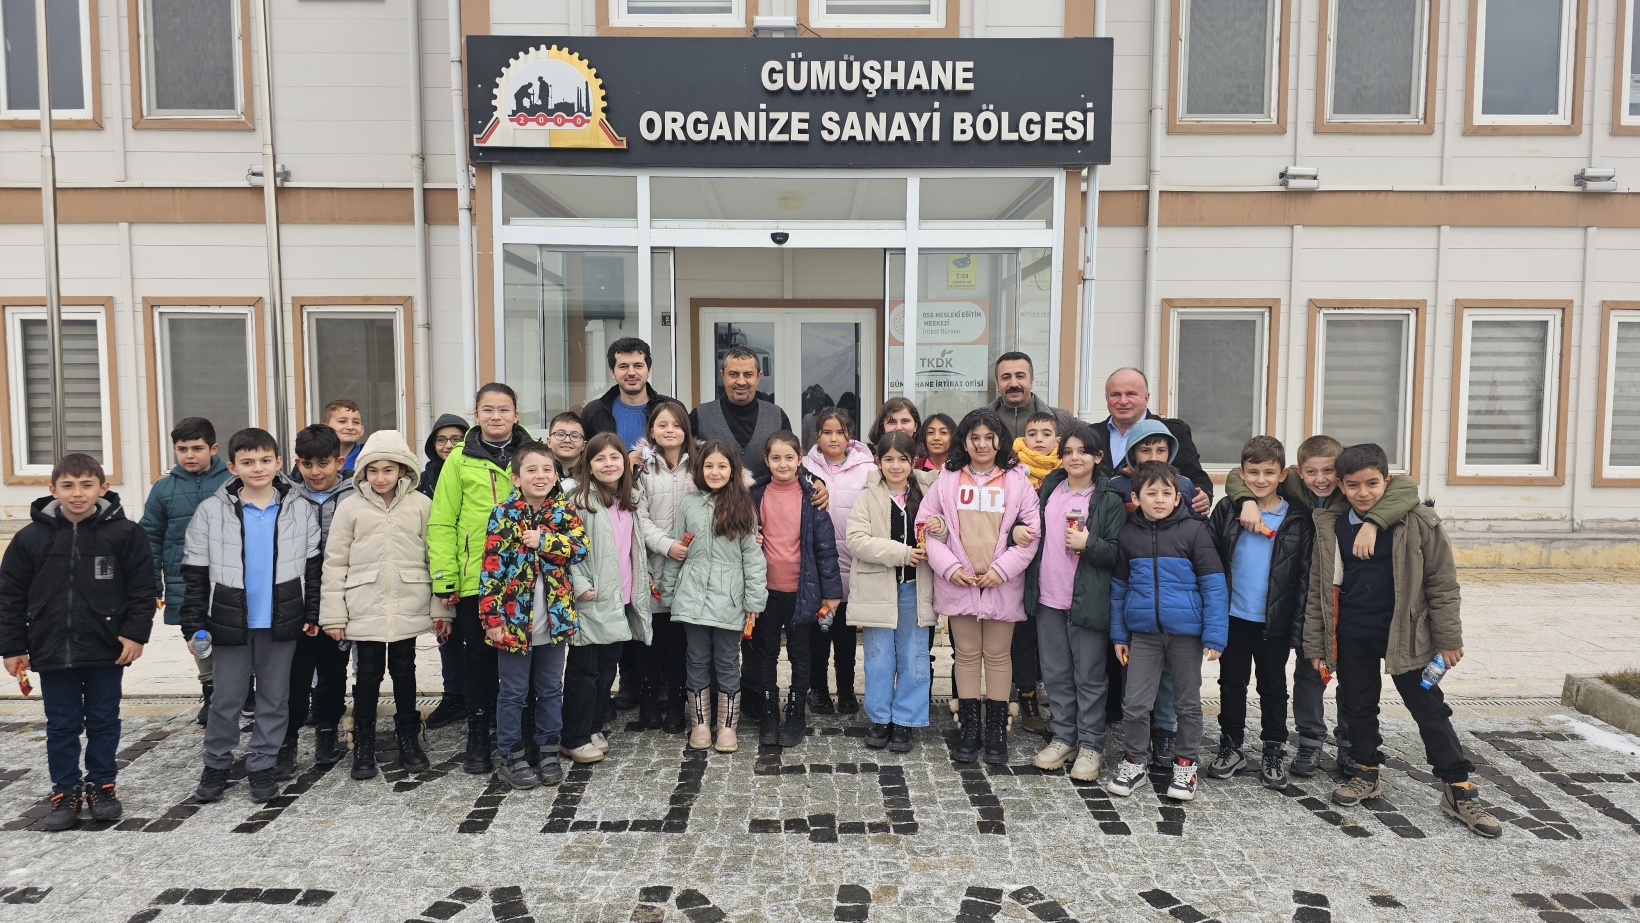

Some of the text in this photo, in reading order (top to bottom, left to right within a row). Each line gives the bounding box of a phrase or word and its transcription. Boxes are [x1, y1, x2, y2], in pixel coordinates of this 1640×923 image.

[761, 52, 974, 98] GÜMÜŞHANE
[519, 116, 582, 125] 2000
[639, 101, 1095, 142] ORGANİZE SANAYİ BÖLGESİ
[923, 319, 950, 327] MERKEZİ
[920, 357, 953, 368] TKDK
[935, 379, 963, 388] İRTİBAT
[965, 379, 984, 387] OFİSİ
[960, 489, 1005, 507] UT
